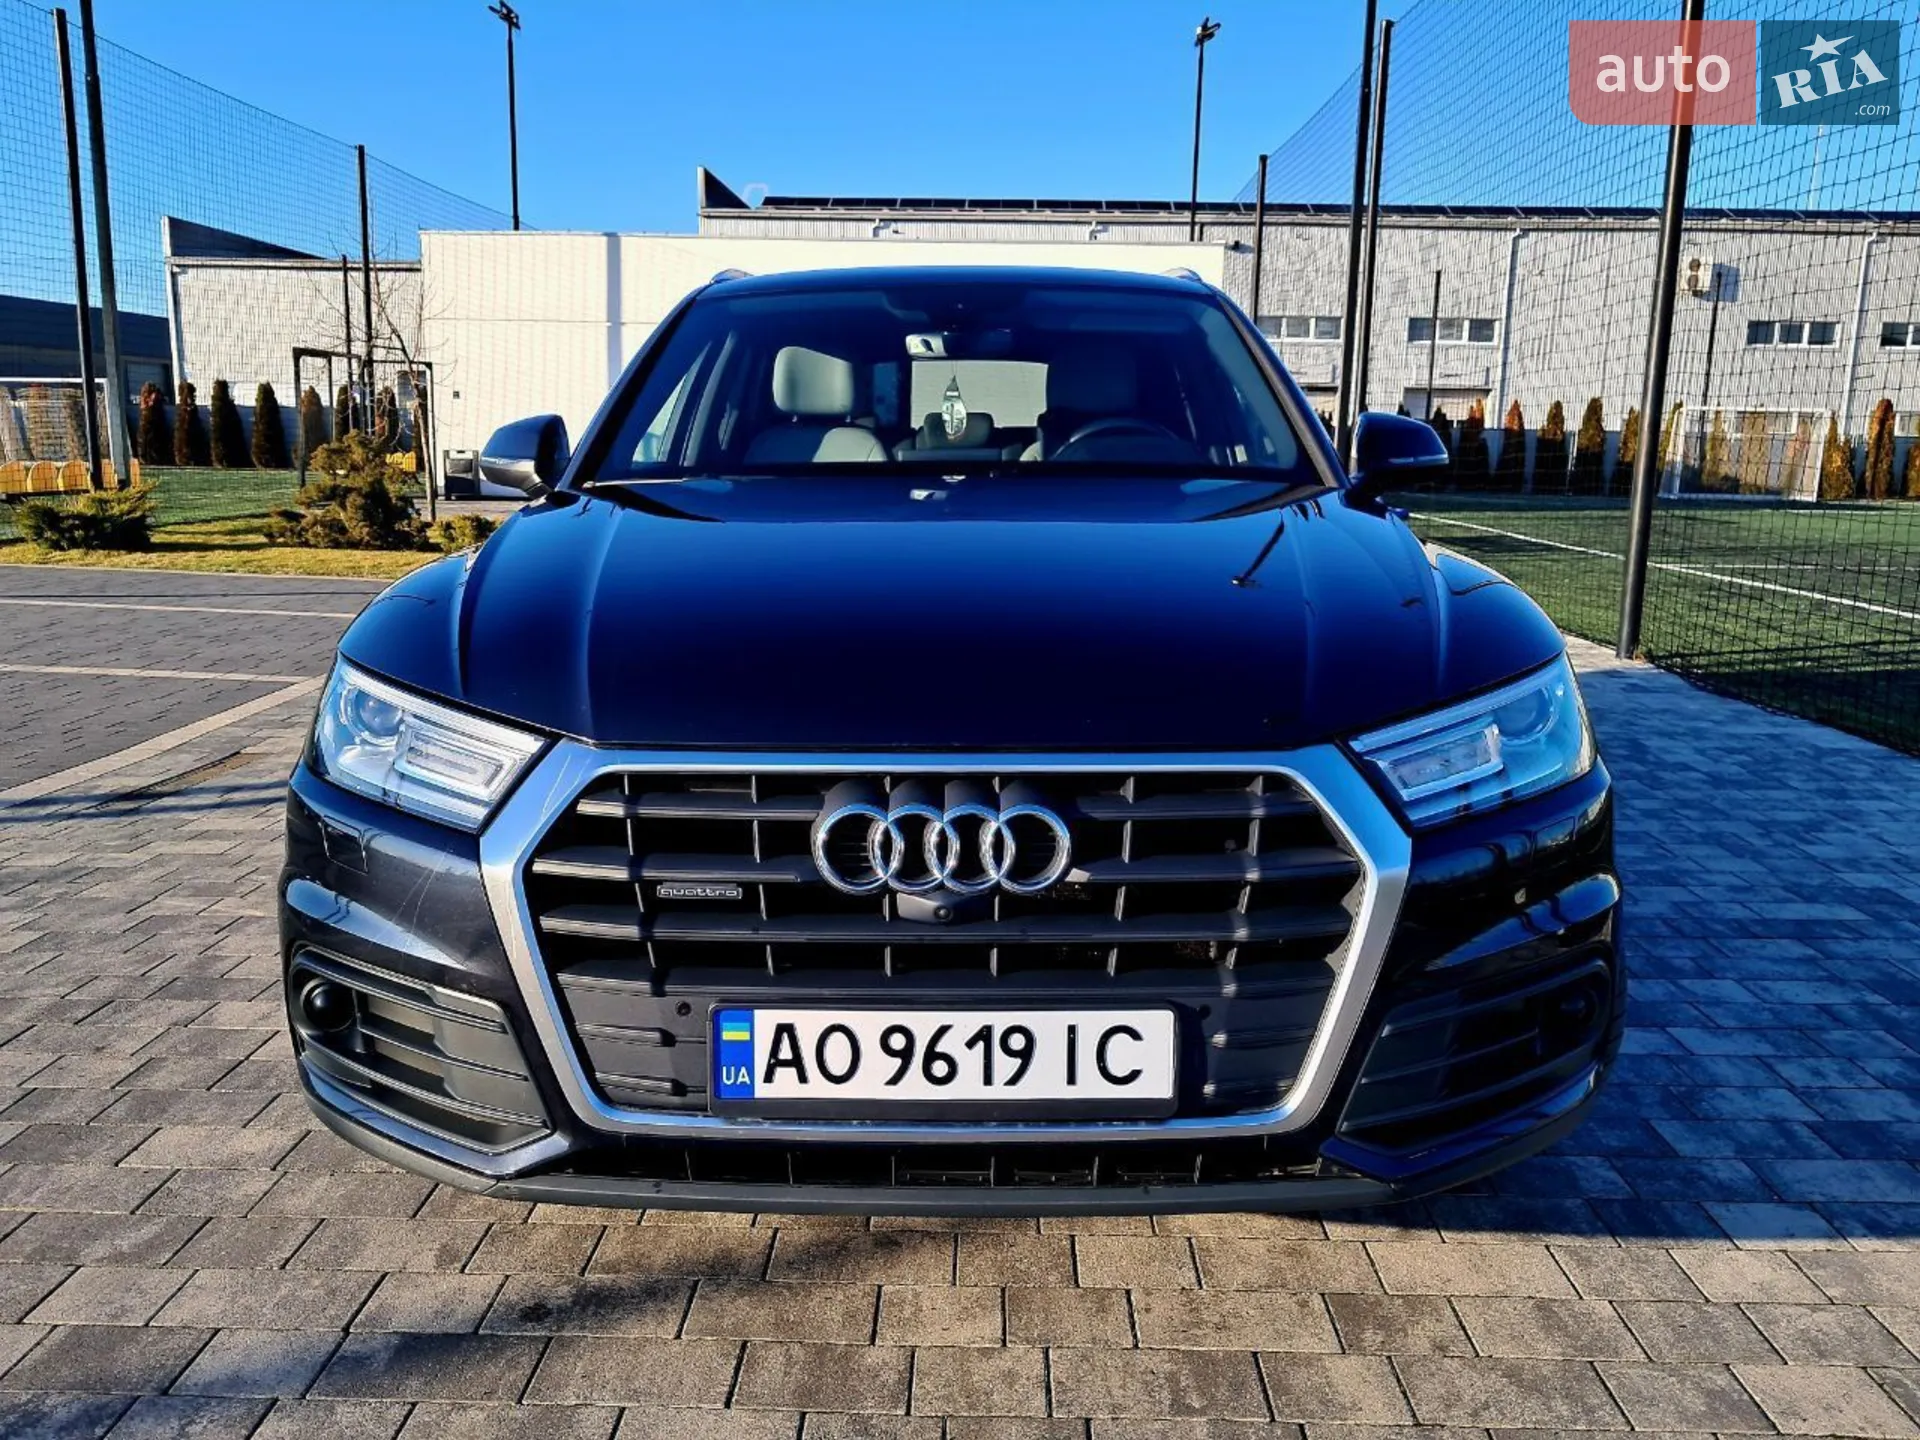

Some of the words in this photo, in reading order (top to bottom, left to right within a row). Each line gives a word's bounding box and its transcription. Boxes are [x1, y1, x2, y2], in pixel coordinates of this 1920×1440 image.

[660, 887, 738, 897] quattro
[763, 1023, 861, 1085] AO
[879, 1024, 1037, 1086] 9619
[1066, 1024, 1144, 1086] IC
[722, 1066, 751, 1085] UA
